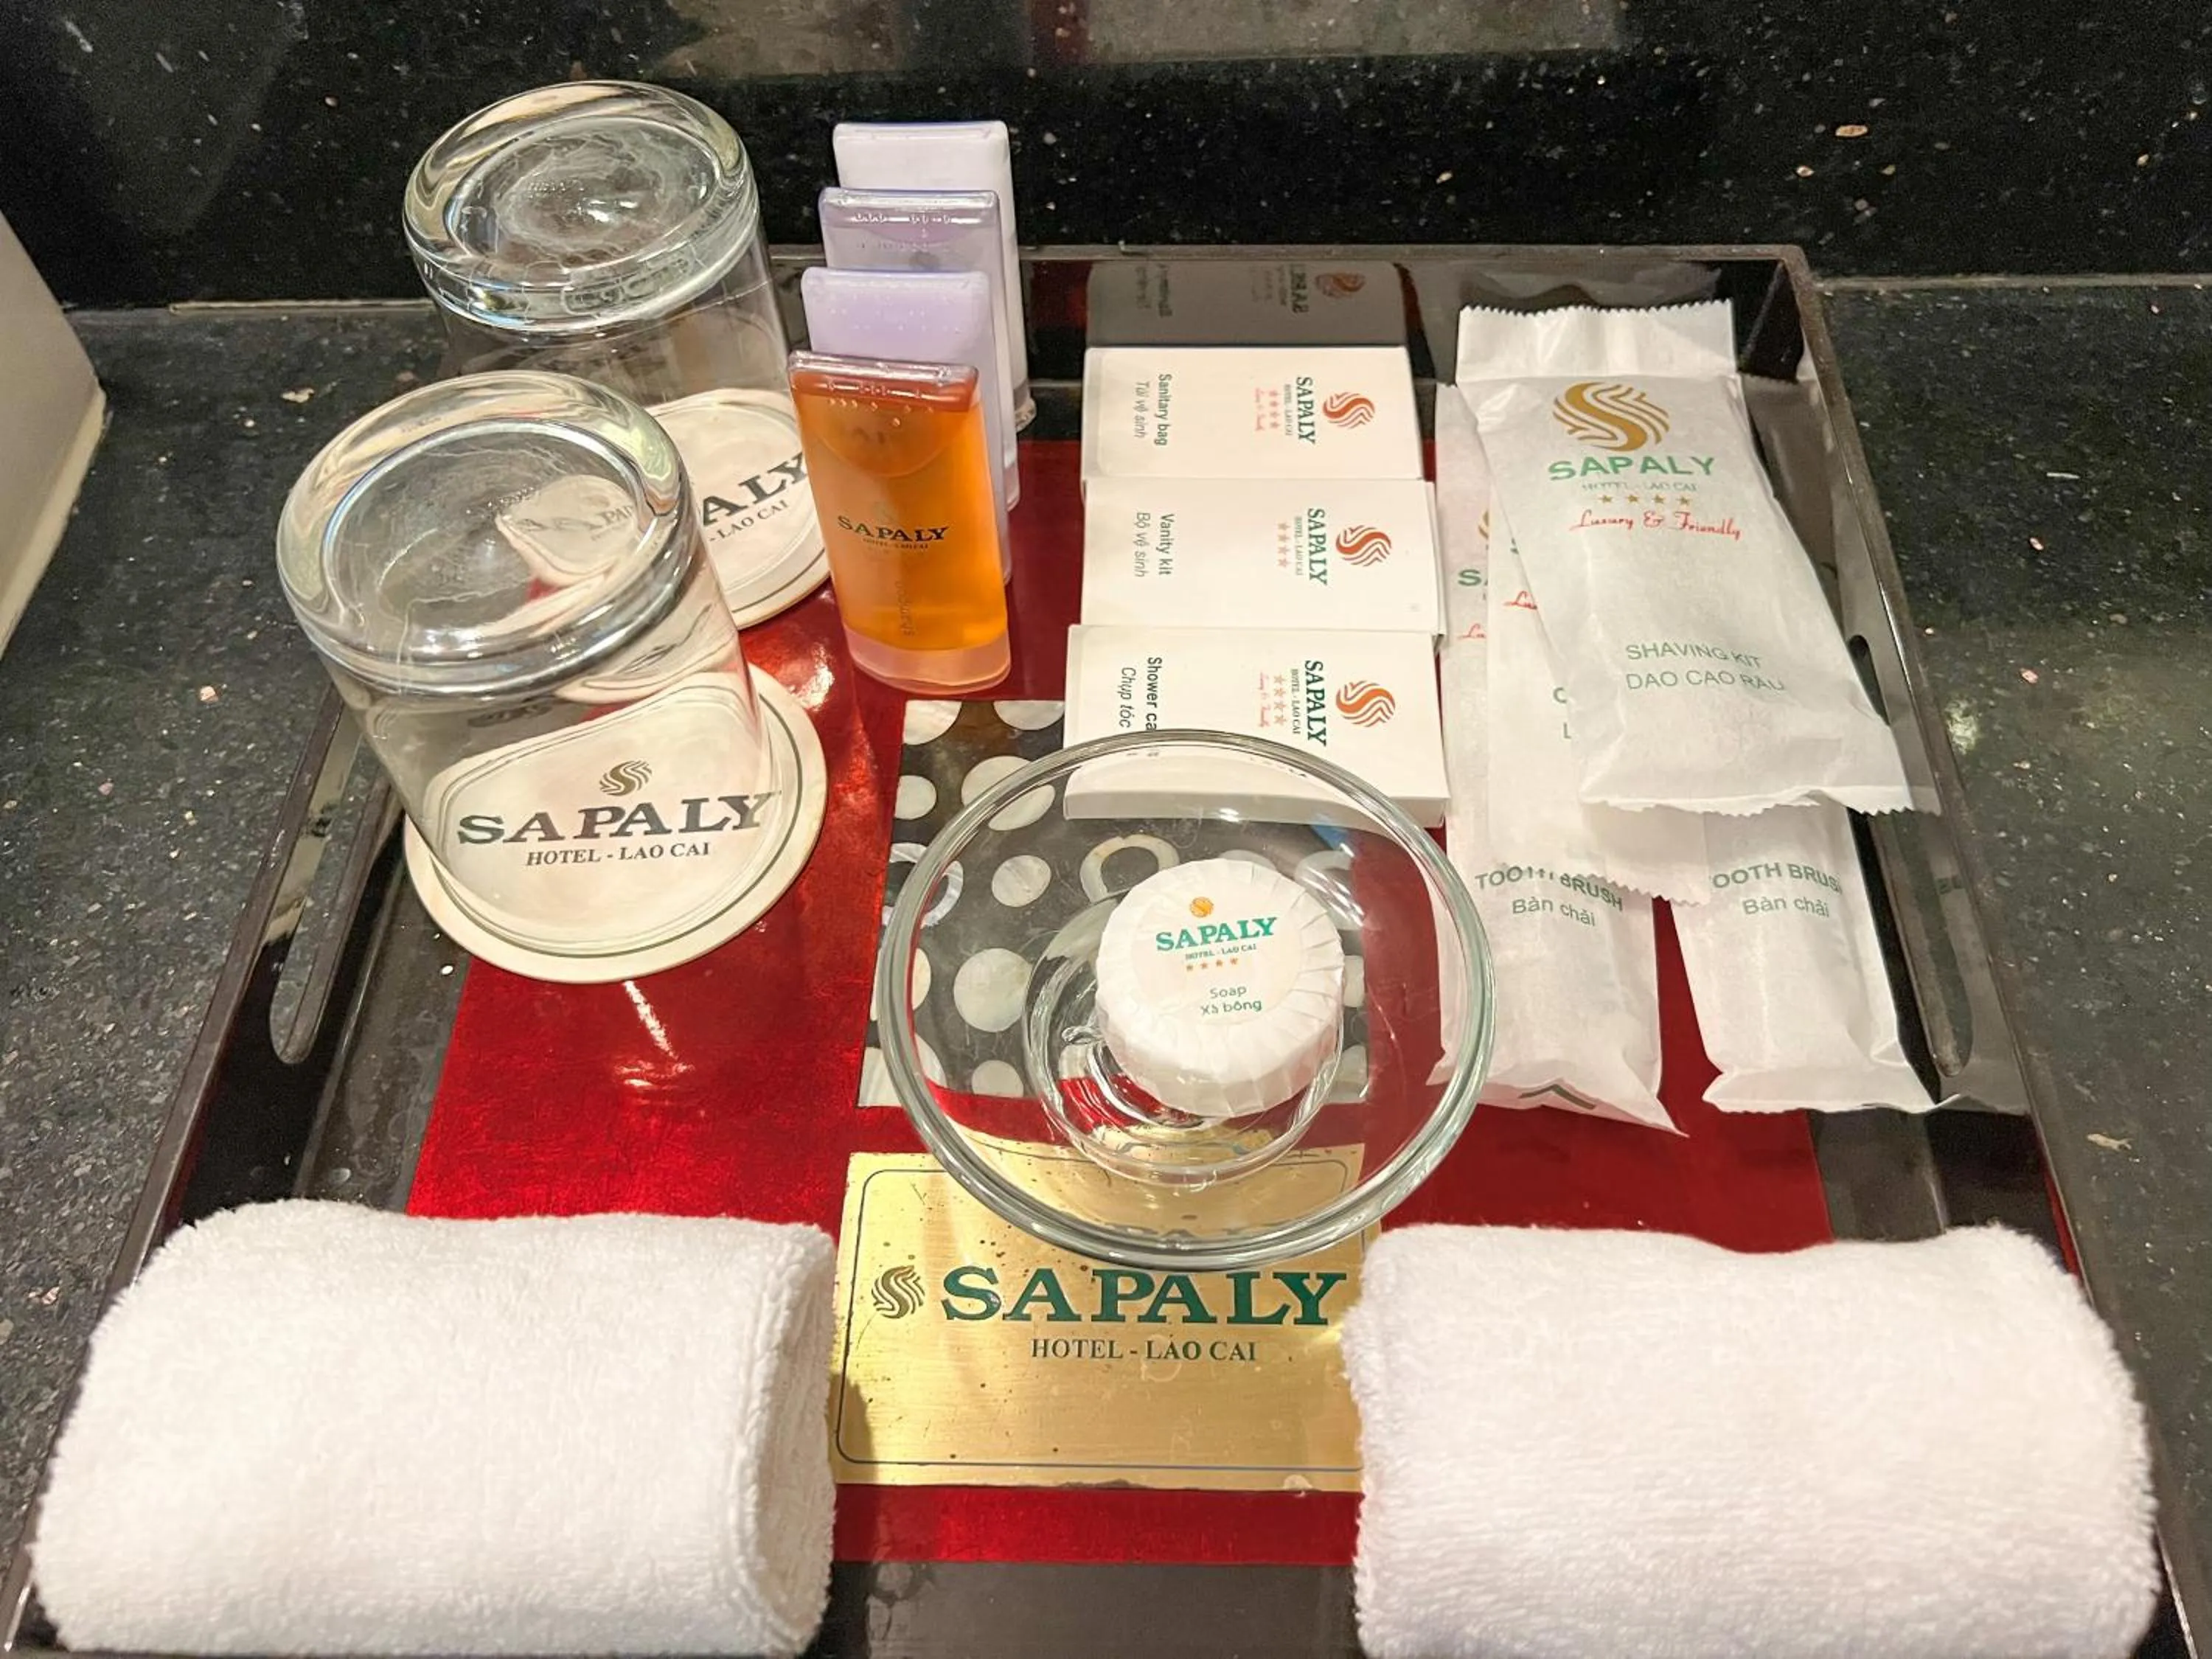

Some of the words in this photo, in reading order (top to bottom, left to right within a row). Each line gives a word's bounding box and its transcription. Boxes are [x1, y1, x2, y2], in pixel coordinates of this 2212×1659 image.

[1154, 374, 1172, 420] Sanitary
[1296, 377, 1316, 444] SAPALY
[1133, 415, 1149, 438] sinh
[1154, 423, 1172, 445] bag
[1548, 456, 1714, 481] SAPALY
[703, 451, 807, 527] ALY
[717, 516, 755, 539] LAO
[757, 499, 788, 520] CAI
[838, 515, 950, 542] SAPALY
[1155, 513, 1175, 554] Vanity
[1569, 509, 1634, 531] Luxury
[1643, 510, 1665, 529] &
[1668, 511, 1741, 540] Friendly
[1307, 508, 1327, 585] SAPALY
[1133, 551, 1149, 577] sinh
[1158, 558, 1173, 574] kit
[1626, 642, 1728, 661] SHAVING
[1731, 651, 1761, 668] KIT
[1146, 657, 1163, 709] Shower
[1626, 671, 1679, 689] DAO
[1686, 669, 1736, 686] CAO
[1304, 660, 1326, 747] SAPALY
[1145, 713, 1158, 731] ca
[458, 790, 782, 844] SAPALY
[526, 850, 602, 866] HOTEL
[619, 844, 664, 861] LAO
[670, 842, 710, 857] CAI
[1559, 872, 1623, 911] BRUSH
[1709, 862, 1782, 888] OOTH
[1787, 863, 1843, 894] BRUS
[1155, 917, 1278, 952] SAPALY
[1209, 986, 1247, 999] Soap
[1222, 999, 1262, 1012] bông
[941, 1265, 1348, 1326] SAPALY
[1032, 1338, 1124, 1359] HOTEL
[1144, 1338, 1202, 1360] LAO
[1208, 1340, 1259, 1361] CAI
